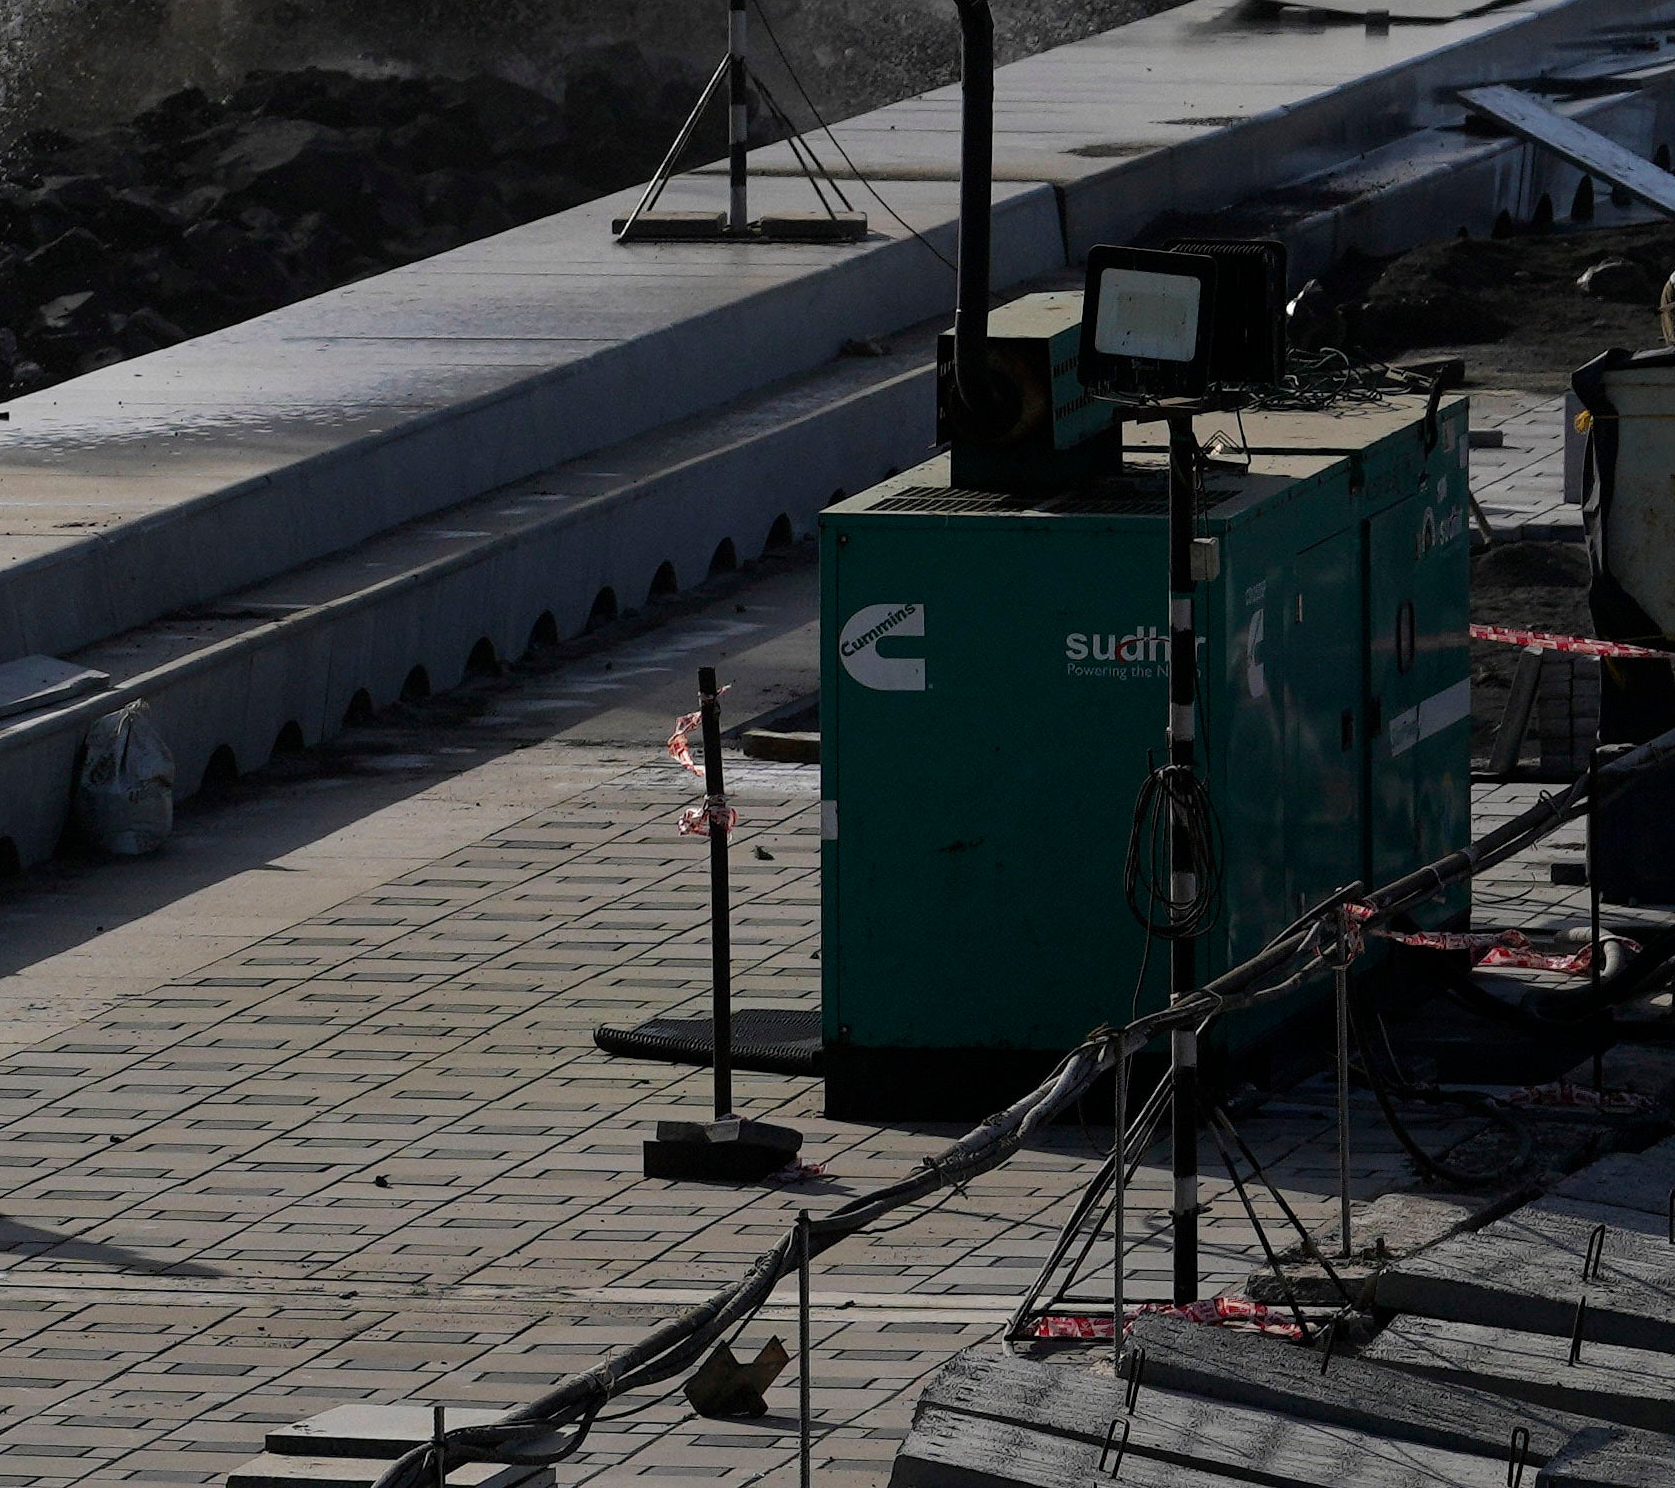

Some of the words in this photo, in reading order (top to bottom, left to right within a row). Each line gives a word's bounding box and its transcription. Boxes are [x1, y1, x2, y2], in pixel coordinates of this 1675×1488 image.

[840, 603, 916, 657] Cummins
[1065, 625, 1206, 662] sudhr
[1066, 663, 1128, 681] Powering
[1131, 664, 1153, 678] the
